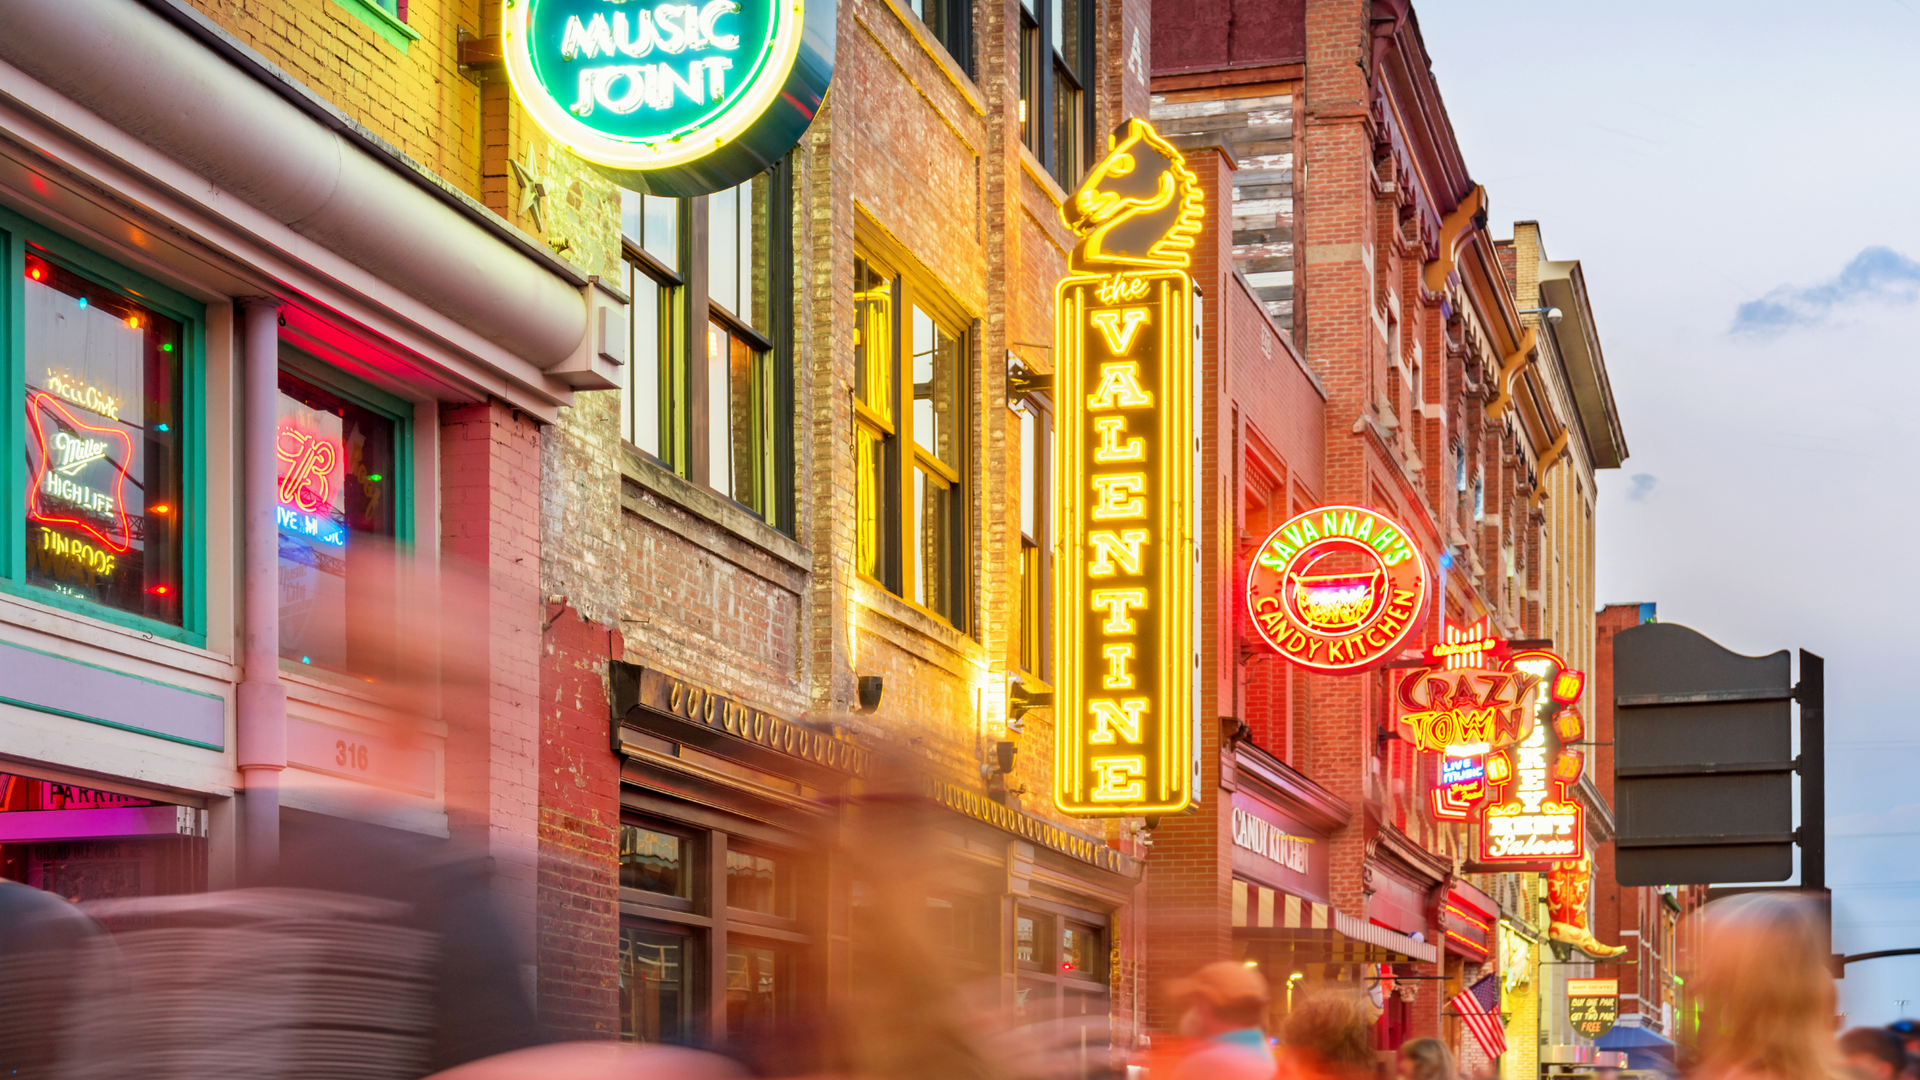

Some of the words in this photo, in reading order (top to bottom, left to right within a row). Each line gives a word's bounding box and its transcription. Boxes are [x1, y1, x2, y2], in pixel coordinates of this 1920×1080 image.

[561, 1, 740, 59] MUSIC
[570, 57, 733, 116] JOINT
[1096, 272, 1150, 304] the
[55, 432, 107, 466] Miller
[47, 470, 82, 504] HIGH
[84, 486, 114, 518] LIFE
[277, 506, 297, 530] IVE
[41, 526, 69, 558] TIN
[72, 539, 115, 576] ROOF
[1087, 306, 1155, 802] VALENTINE
[1258, 511, 1413, 573] SAVANNAH'S
[1256, 596, 1323, 660] CANDY
[1328, 589, 1415, 662] KITCHEN
[1433, 642, 1482, 656] Welcome
[1482, 638, 1496, 651] to
[1397, 667, 1543, 711] CRAZY
[1557, 676, 1580, 698] WB
[1400, 707, 1525, 751] TOWN
[1558, 715, 1581, 738] WB
[336, 739, 369, 771] 316
[1443, 757, 1472, 772] LIVE
[1486, 757, 1509, 781] WB
[1557, 754, 1582, 779] WB
[1443, 765, 1484, 784] MUSIC
[1488, 815, 1574, 835] BENT
[1232, 807, 1268, 857] CANDY
[1268, 824, 1309, 875] KITCHEN
[1489, 833, 1575, 856] Saloon
[1570, 1012, 1584, 1021] GET
[1584, 1012, 1598, 1021] TWO
[1598, 1012, 1615, 1021] PAIR
[1571, 998, 1586, 1007] BUY
[1585, 998, 1599, 1007] ONE
[1599, 998, 1615, 1007] PAIR
[1580, 1021, 1602, 1033] FREE
